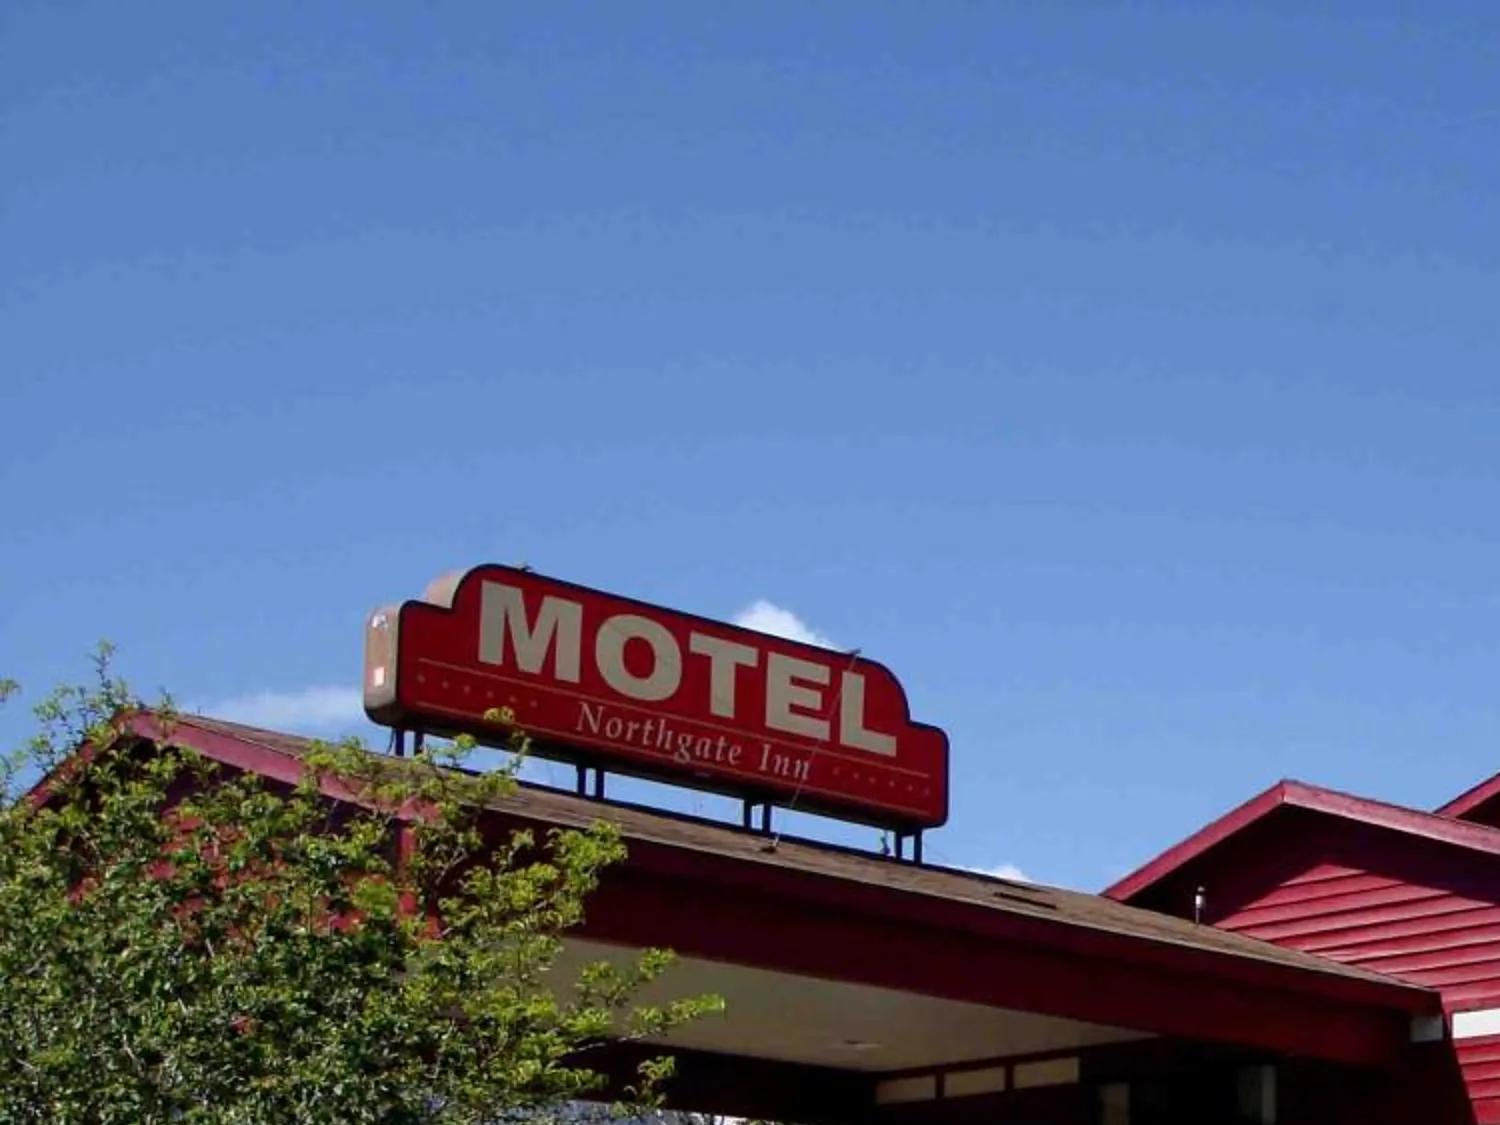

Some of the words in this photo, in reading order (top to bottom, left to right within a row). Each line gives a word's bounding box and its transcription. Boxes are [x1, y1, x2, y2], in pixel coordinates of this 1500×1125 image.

[478, 580, 897, 756] MOTEL
[576, 702, 742, 765] Northgate
[759, 744, 811, 781] Inn
